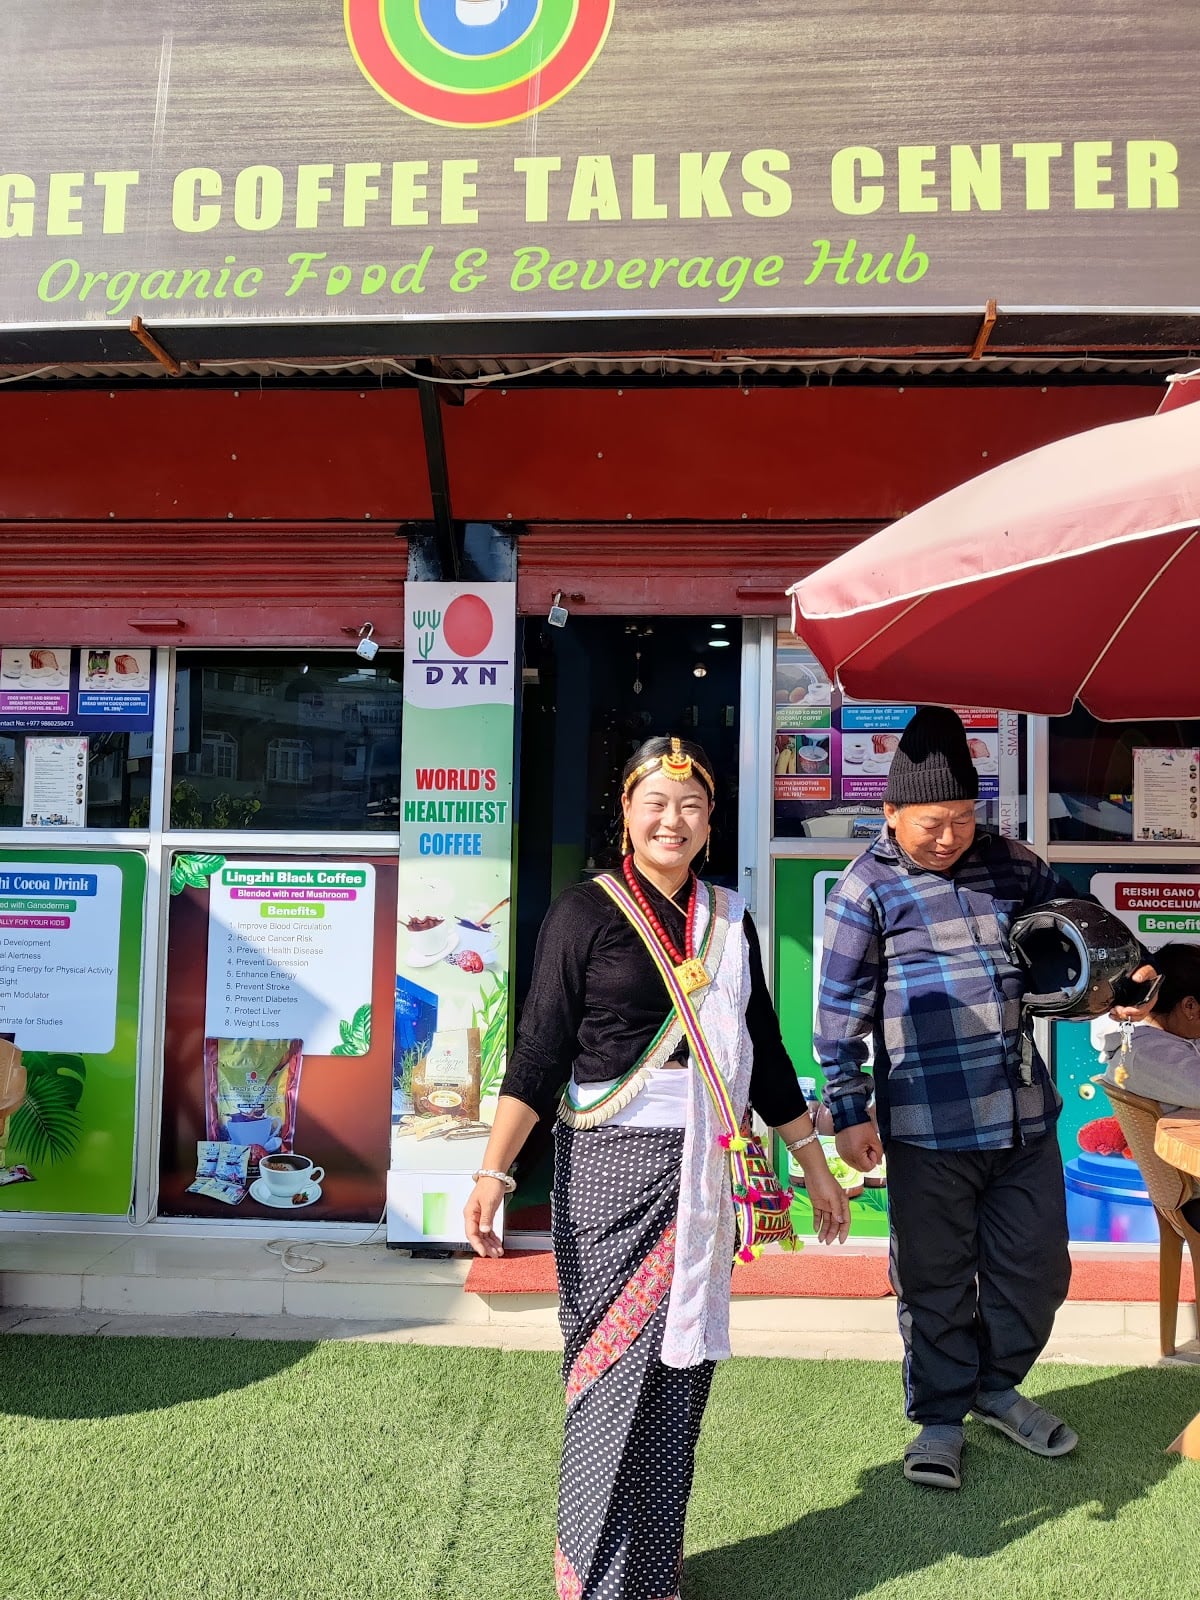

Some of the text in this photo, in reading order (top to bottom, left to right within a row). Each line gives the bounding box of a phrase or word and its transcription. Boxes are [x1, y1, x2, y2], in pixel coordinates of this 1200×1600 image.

[0, 139, 1180, 238] GET COFFEE TALKS CENTER
[36, 232, 930, 315] Organic Food & Beverage Hub
[425, 666, 497, 686] DXN
[1007, 711, 1018, 757] SMART
[415, 767, 497, 792] WORLD'S
[403, 800, 508, 824] HEALTHIEST
[1000, 799, 1012, 839] MART
[418, 832, 482, 856] COFFEE
[226, 870, 363, 885] Lingzhi Black Coffee
[13, 876, 50, 890] Cocoa
[53, 876, 89, 891] Drink
[237, 889, 349, 899] Blended with red Mushroom
[1122, 887, 1195, 897] REISHI GANO
[11, 901, 25, 909] with
[26, 901, 70, 910] Ganoderma
[1127, 899, 1200, 909] GANOCELIUM
[267, 905, 318, 916] Benefits
[237, 922, 268, 931] Improve
[269, 922, 291, 930] Blood
[292, 922, 333, 931] Circulation
[3, 938, 51, 948] Development
[237, 933, 266, 942] Reduce
[267, 933, 294, 943] Cancer
[296, 934, 313, 943] Risk
[227, 945, 324, 955] 3. Prevent Health Disease
[8, 951, 41, 960] Alertness
[227, 958, 309, 968] 4. Prevent Depression
[17, 964, 43, 975] Energy
[44, 965, 54, 973] for
[56, 965, 86, 975] Physical
[87, 965, 114, 976] Activity
[226, 970, 297, 981] 5. Enhance Energy
[226, 982, 290, 991] 5. Prevent Stroke
[13, 991, 50, 999] Modulator
[225, 994, 299, 1003] 6. Prevent Diabetes
[234, 1006, 261, 1015] Protect
[262, 1007, 282, 1015] Liver
[24, 1017, 35, 1025] for
[36, 1017, 64, 1026] Studies
[224, 1018, 280, 1029] 8. Weight Loss
